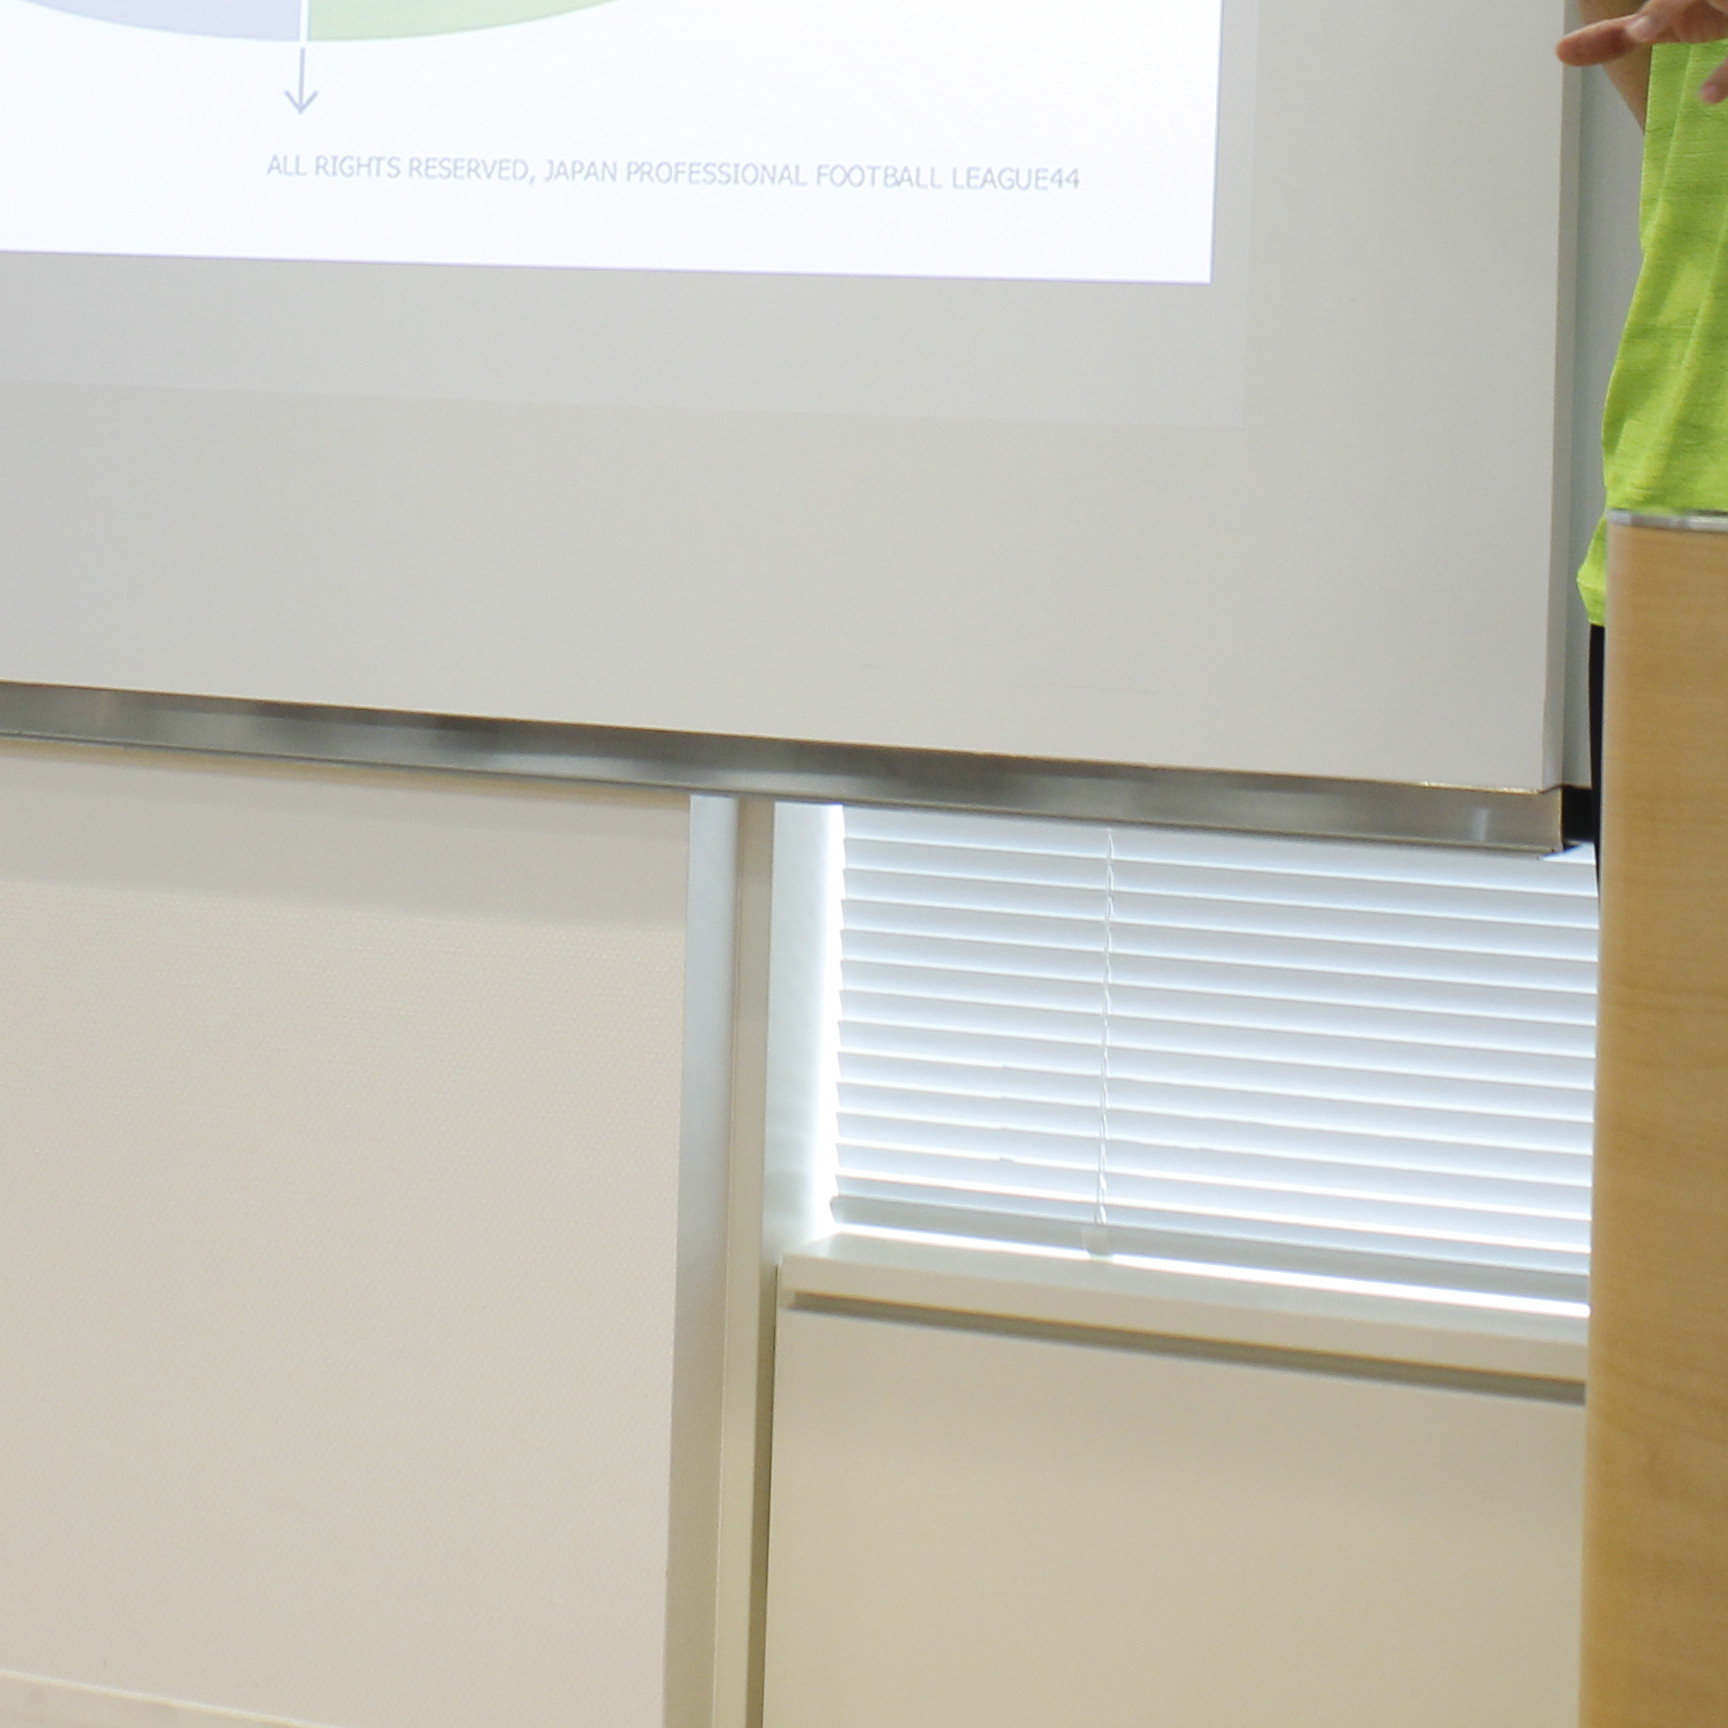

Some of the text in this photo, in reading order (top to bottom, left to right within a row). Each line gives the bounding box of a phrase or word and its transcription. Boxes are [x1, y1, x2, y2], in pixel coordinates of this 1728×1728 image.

[267, 155, 1080, 190] ALL RIGHTS RESERVED, JAPAN PROFESSIONAL FOOTBALL LEAGUE44
